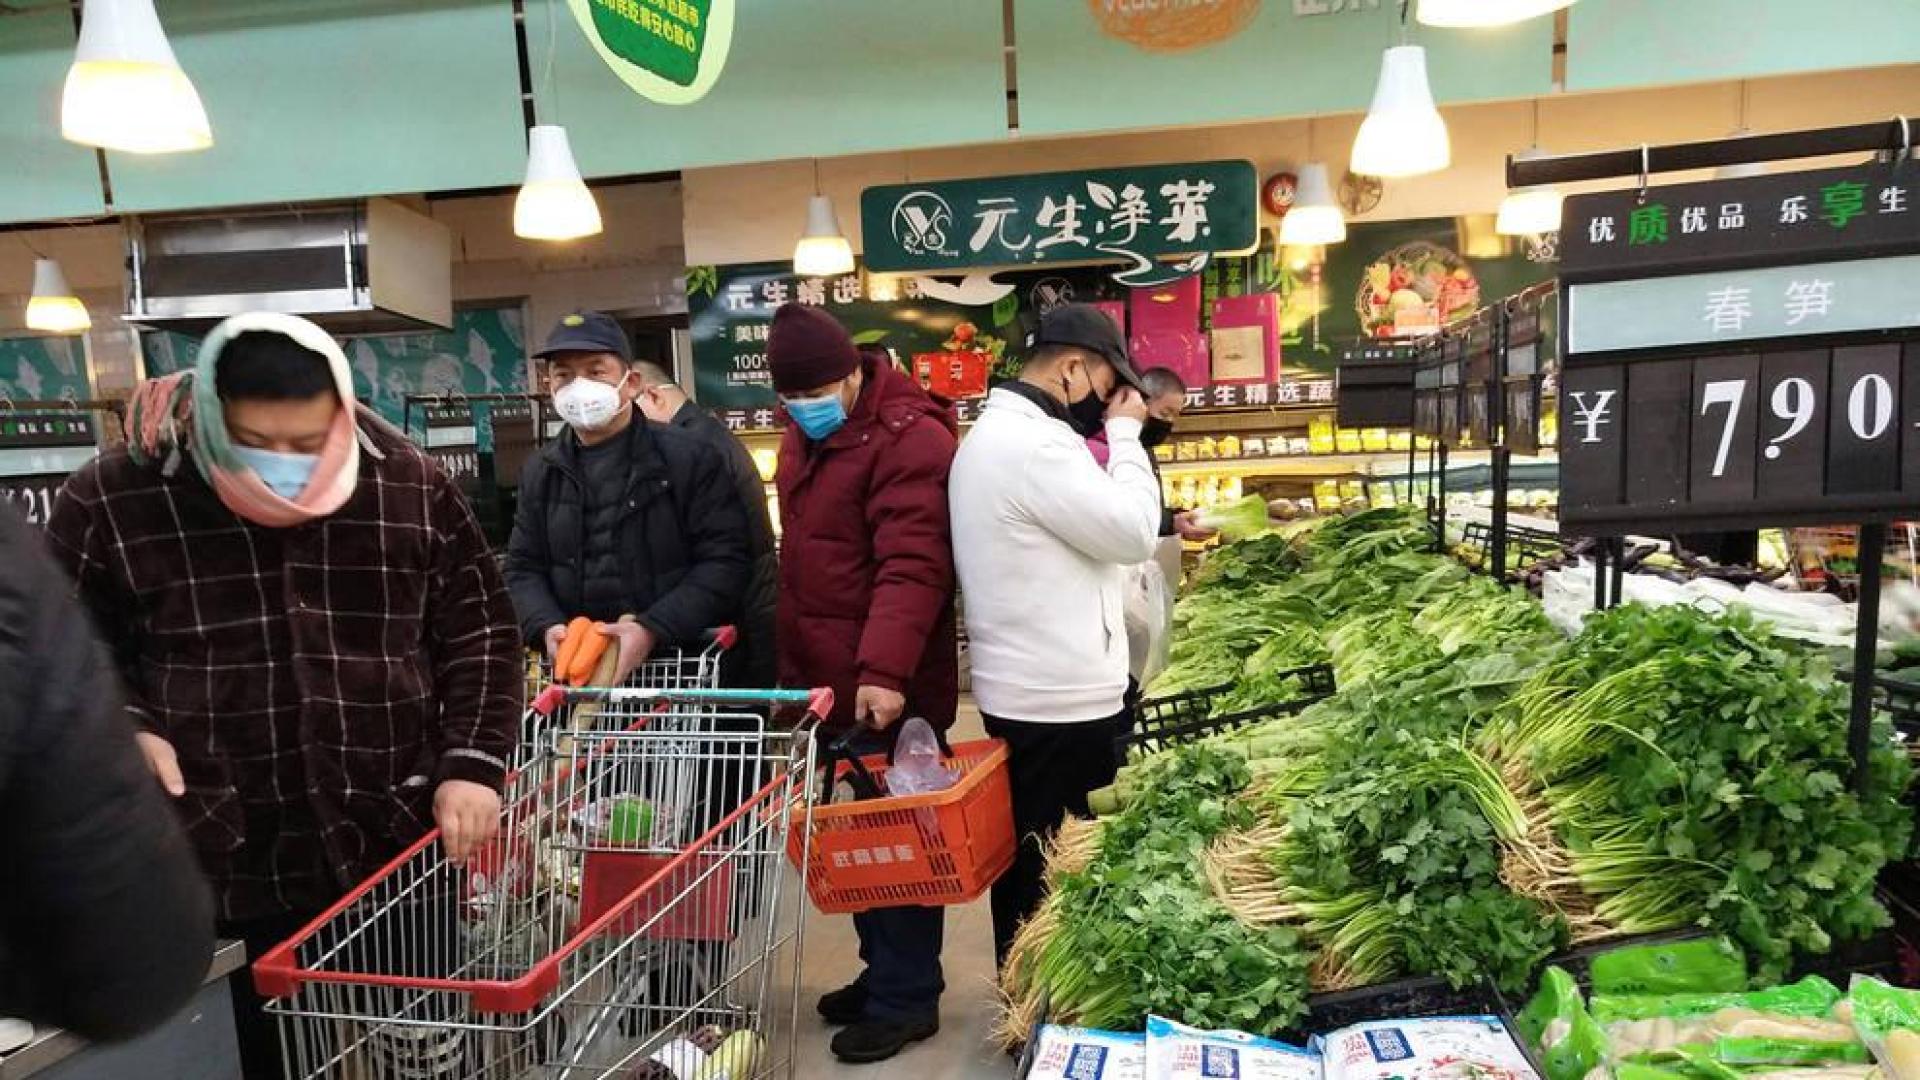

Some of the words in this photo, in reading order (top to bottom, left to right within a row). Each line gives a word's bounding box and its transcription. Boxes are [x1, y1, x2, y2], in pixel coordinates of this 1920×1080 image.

[968, 179, 1216, 253] 元生净菜
[1588, 203, 1746, 247] 优质优品
[1778, 181, 1908, 229] 乐享生
[1704, 278, 1836, 333] 春笋
[1568, 389, 1618, 443] ¥
